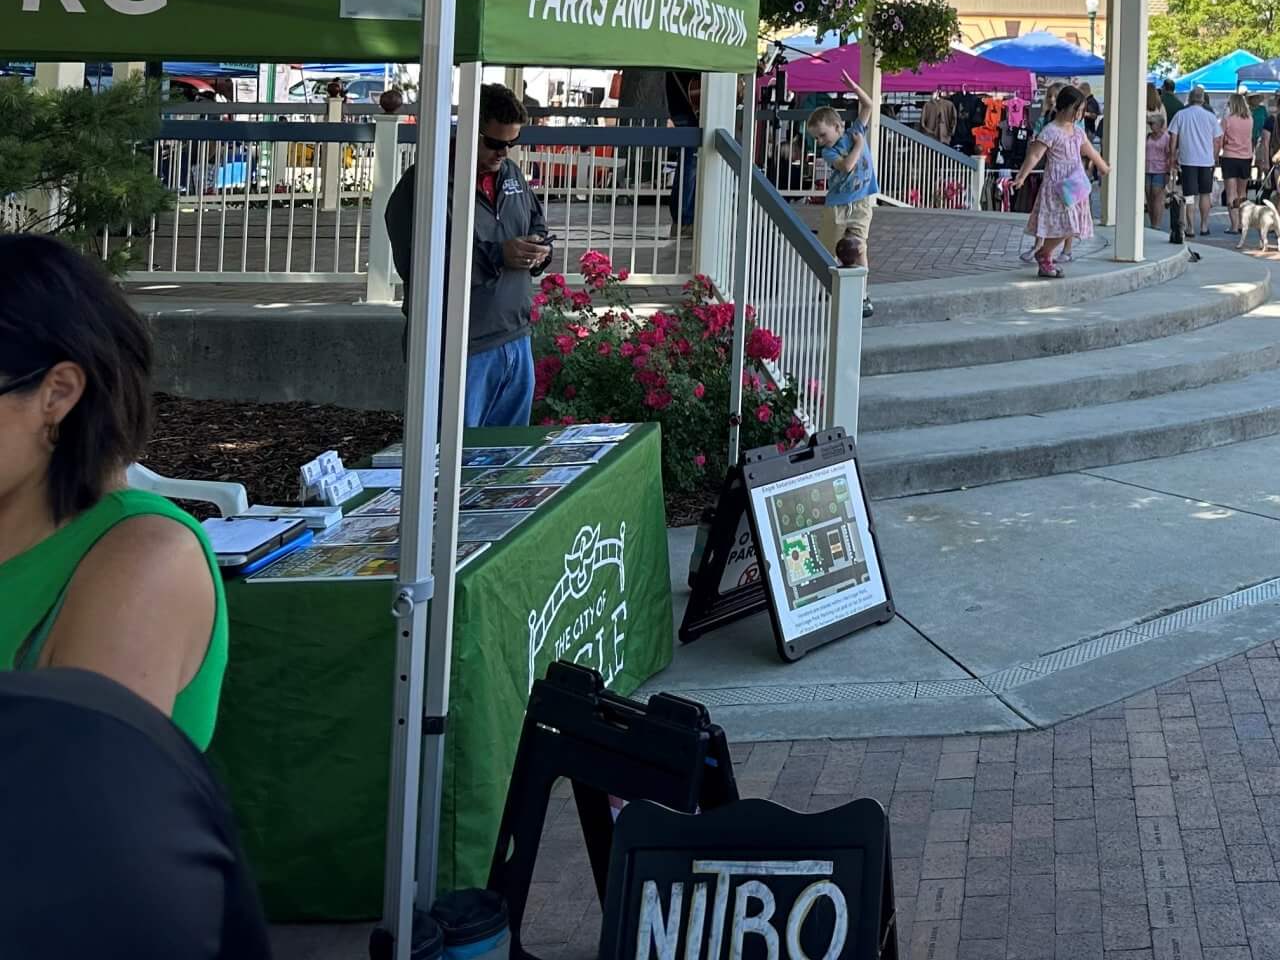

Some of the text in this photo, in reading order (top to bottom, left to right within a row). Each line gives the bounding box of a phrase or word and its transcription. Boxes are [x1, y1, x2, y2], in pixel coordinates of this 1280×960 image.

[554, 589, 607, 663] THE CITY OF
[635, 859, 849, 960] NITRO
